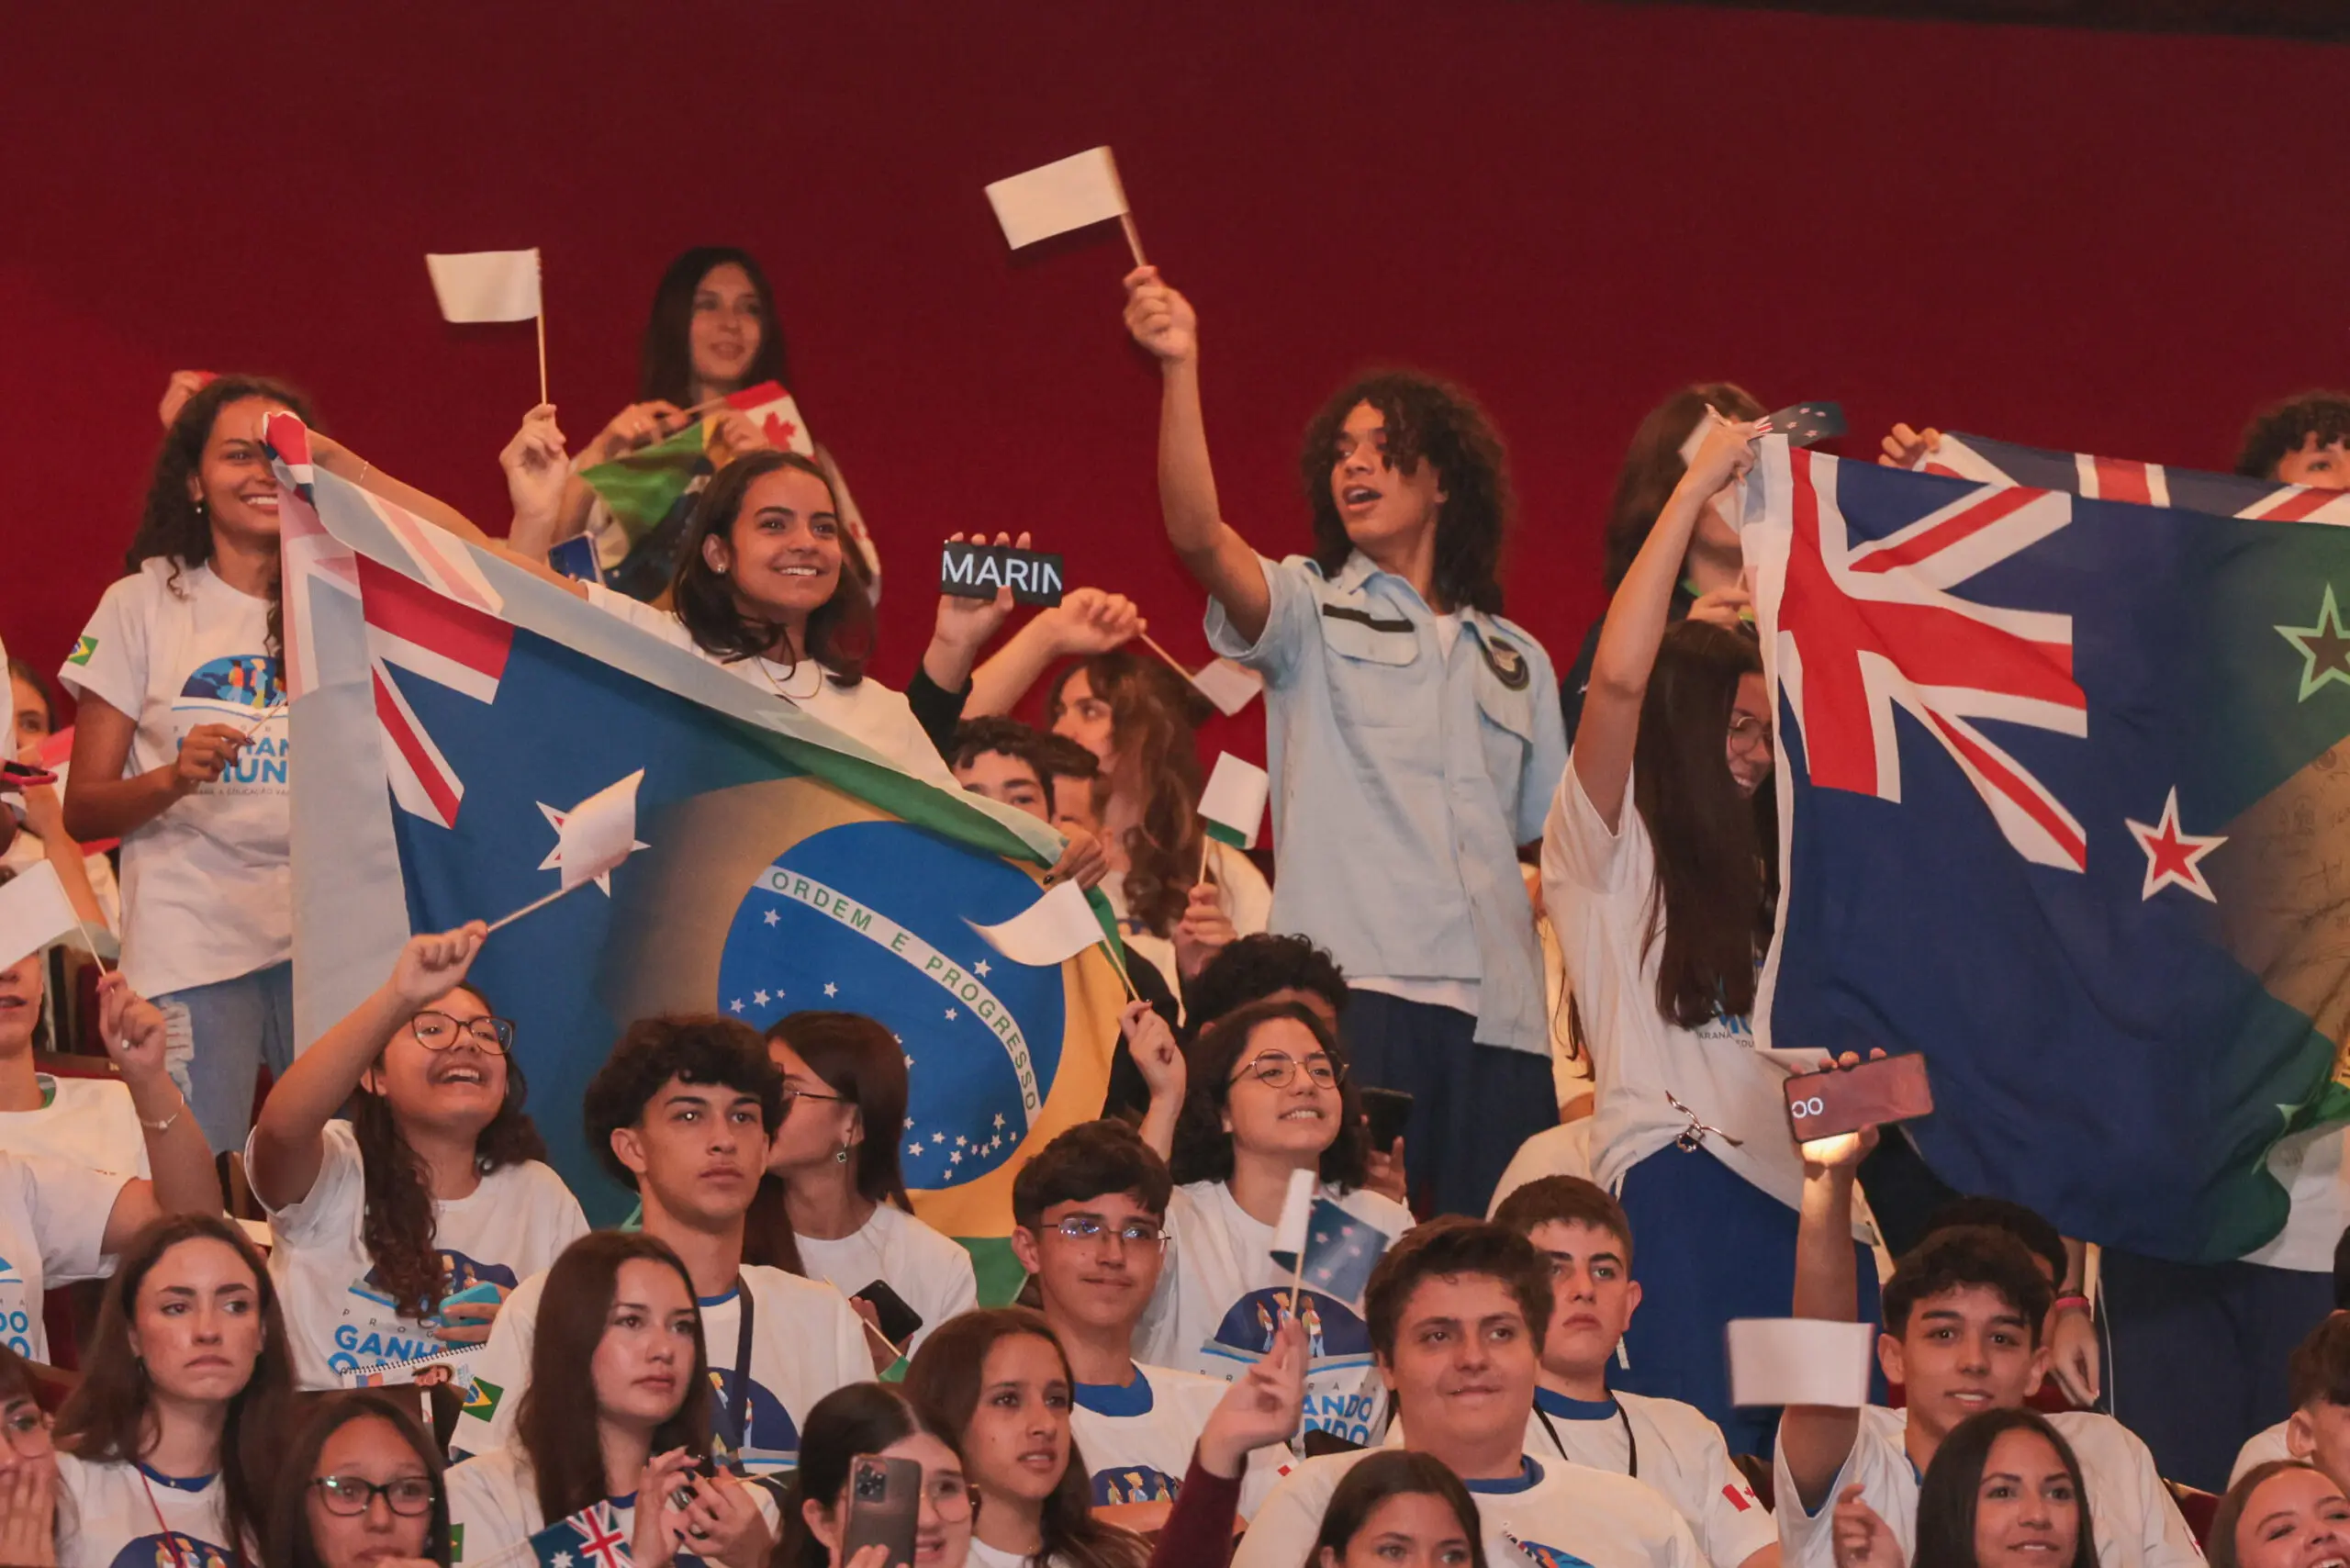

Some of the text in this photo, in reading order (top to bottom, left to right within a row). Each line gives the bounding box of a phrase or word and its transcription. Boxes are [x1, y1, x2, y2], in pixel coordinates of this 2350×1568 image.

[942, 550, 1062, 594] MARIN
[771, 872, 1036, 1110] ORDEM E PROGRESSO
